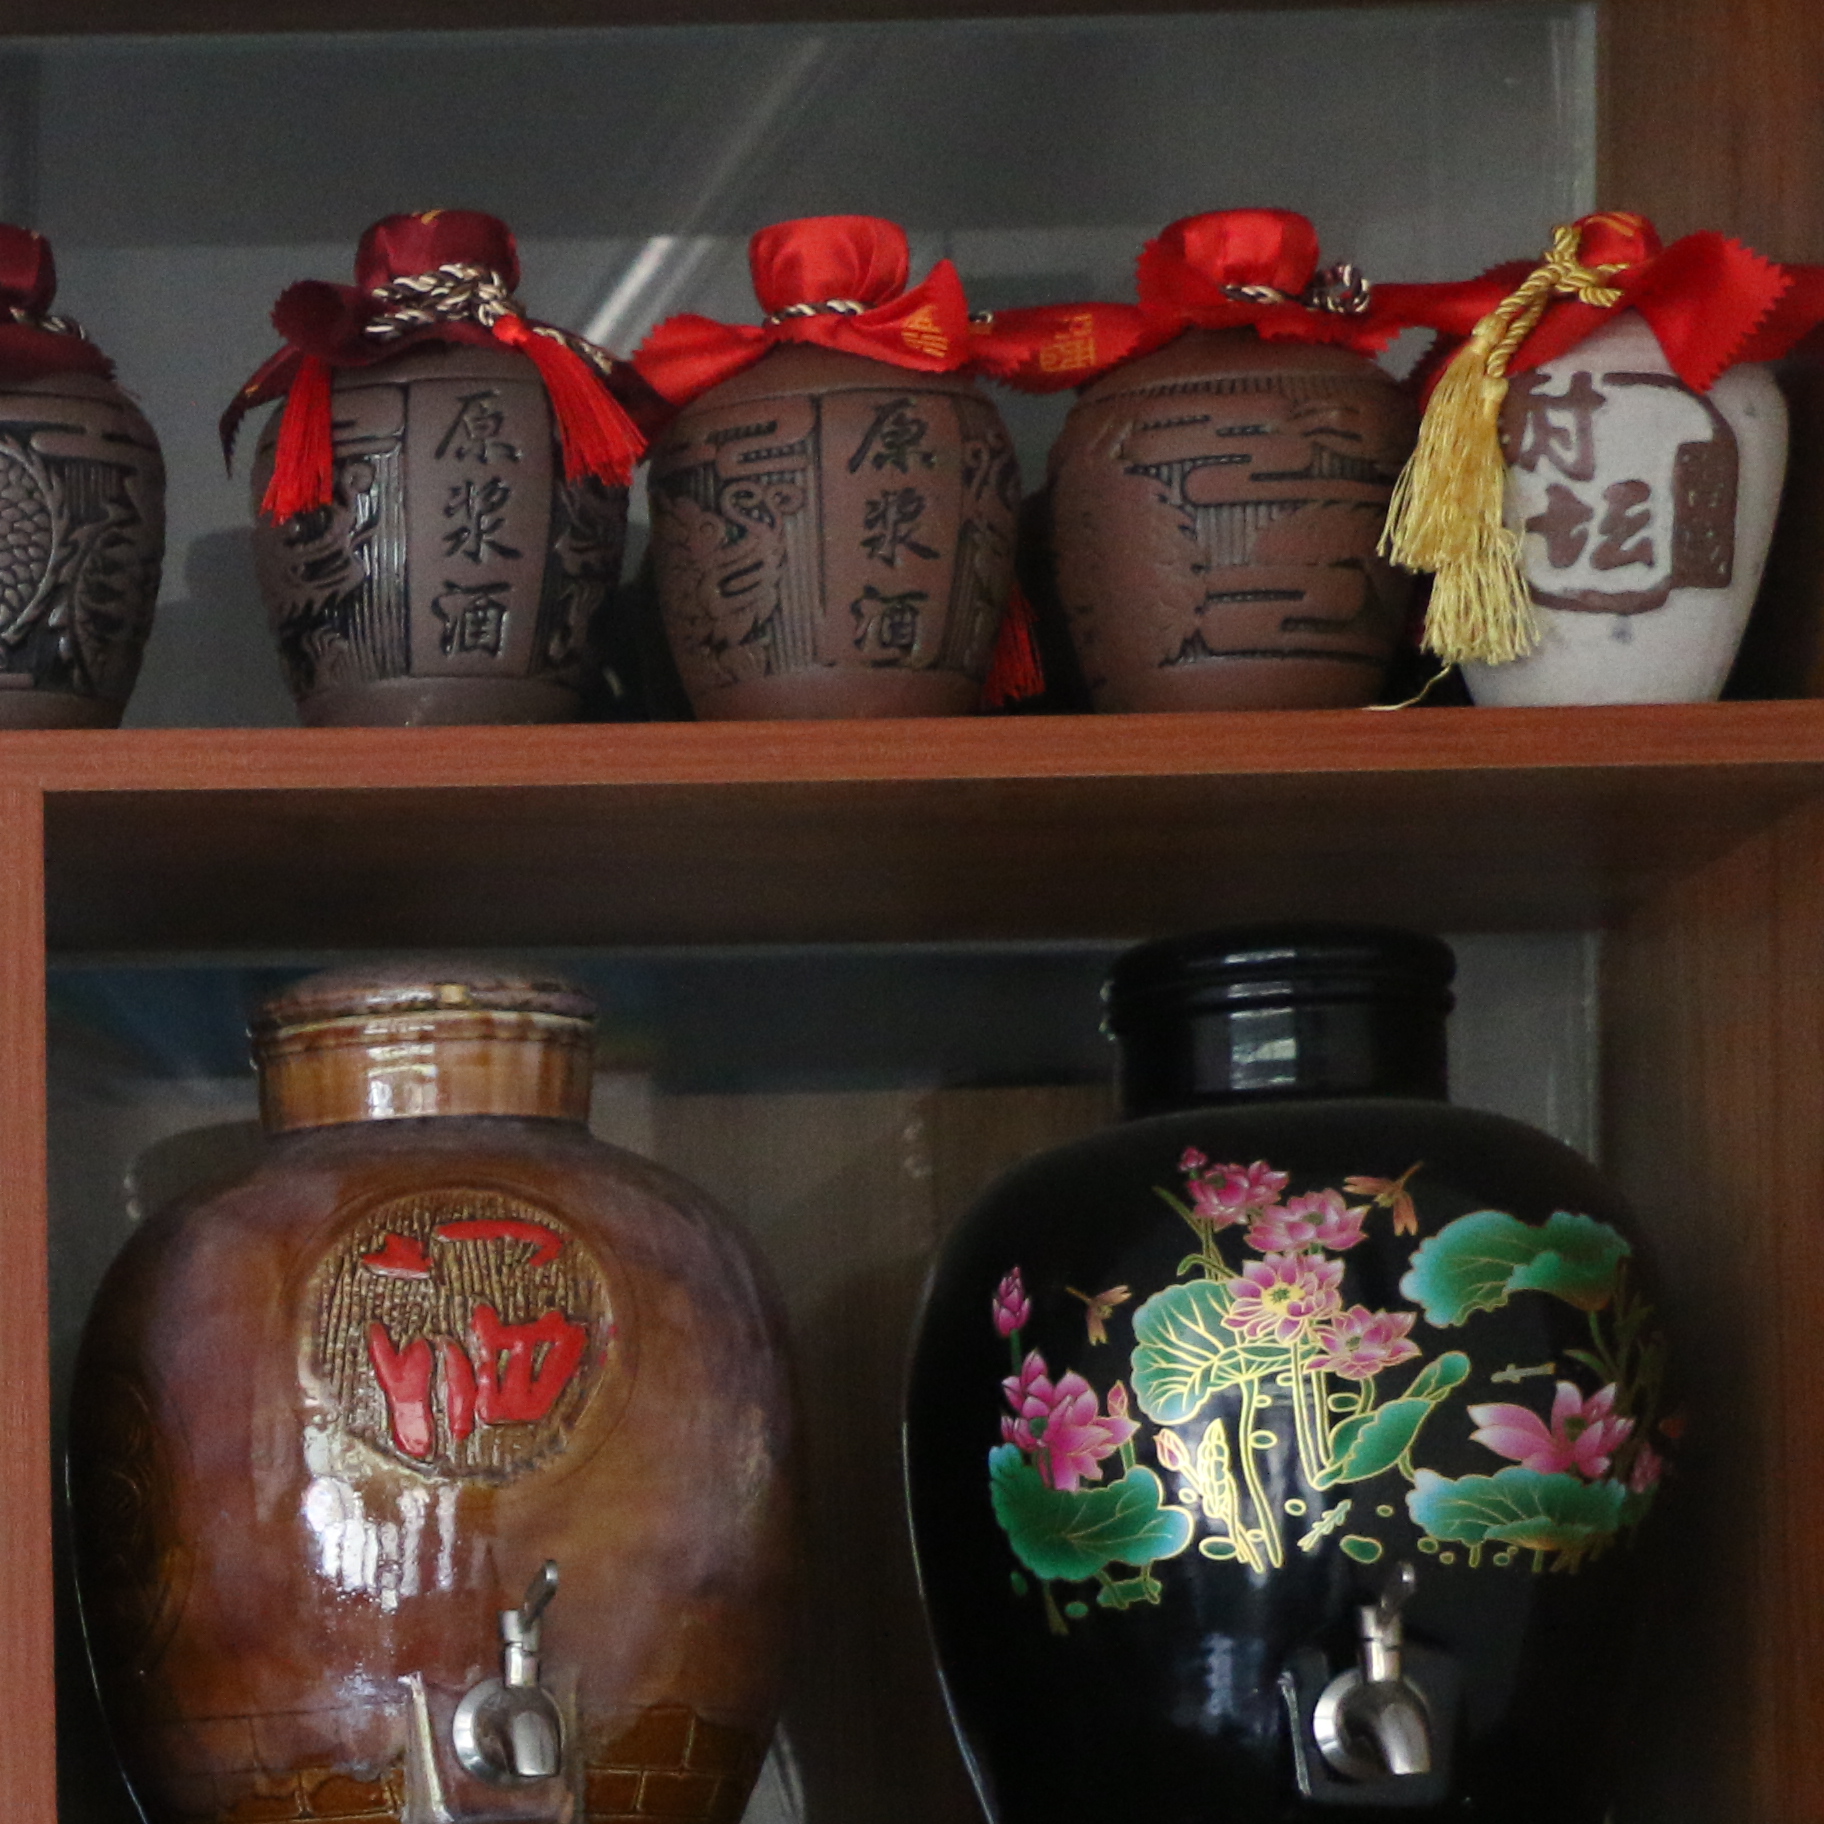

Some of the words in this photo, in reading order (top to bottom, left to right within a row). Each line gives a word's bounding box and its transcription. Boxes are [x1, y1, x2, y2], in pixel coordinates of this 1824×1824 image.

[435, 387, 524, 659] 原浆酒
[846, 397, 940, 656] 原浆酒
